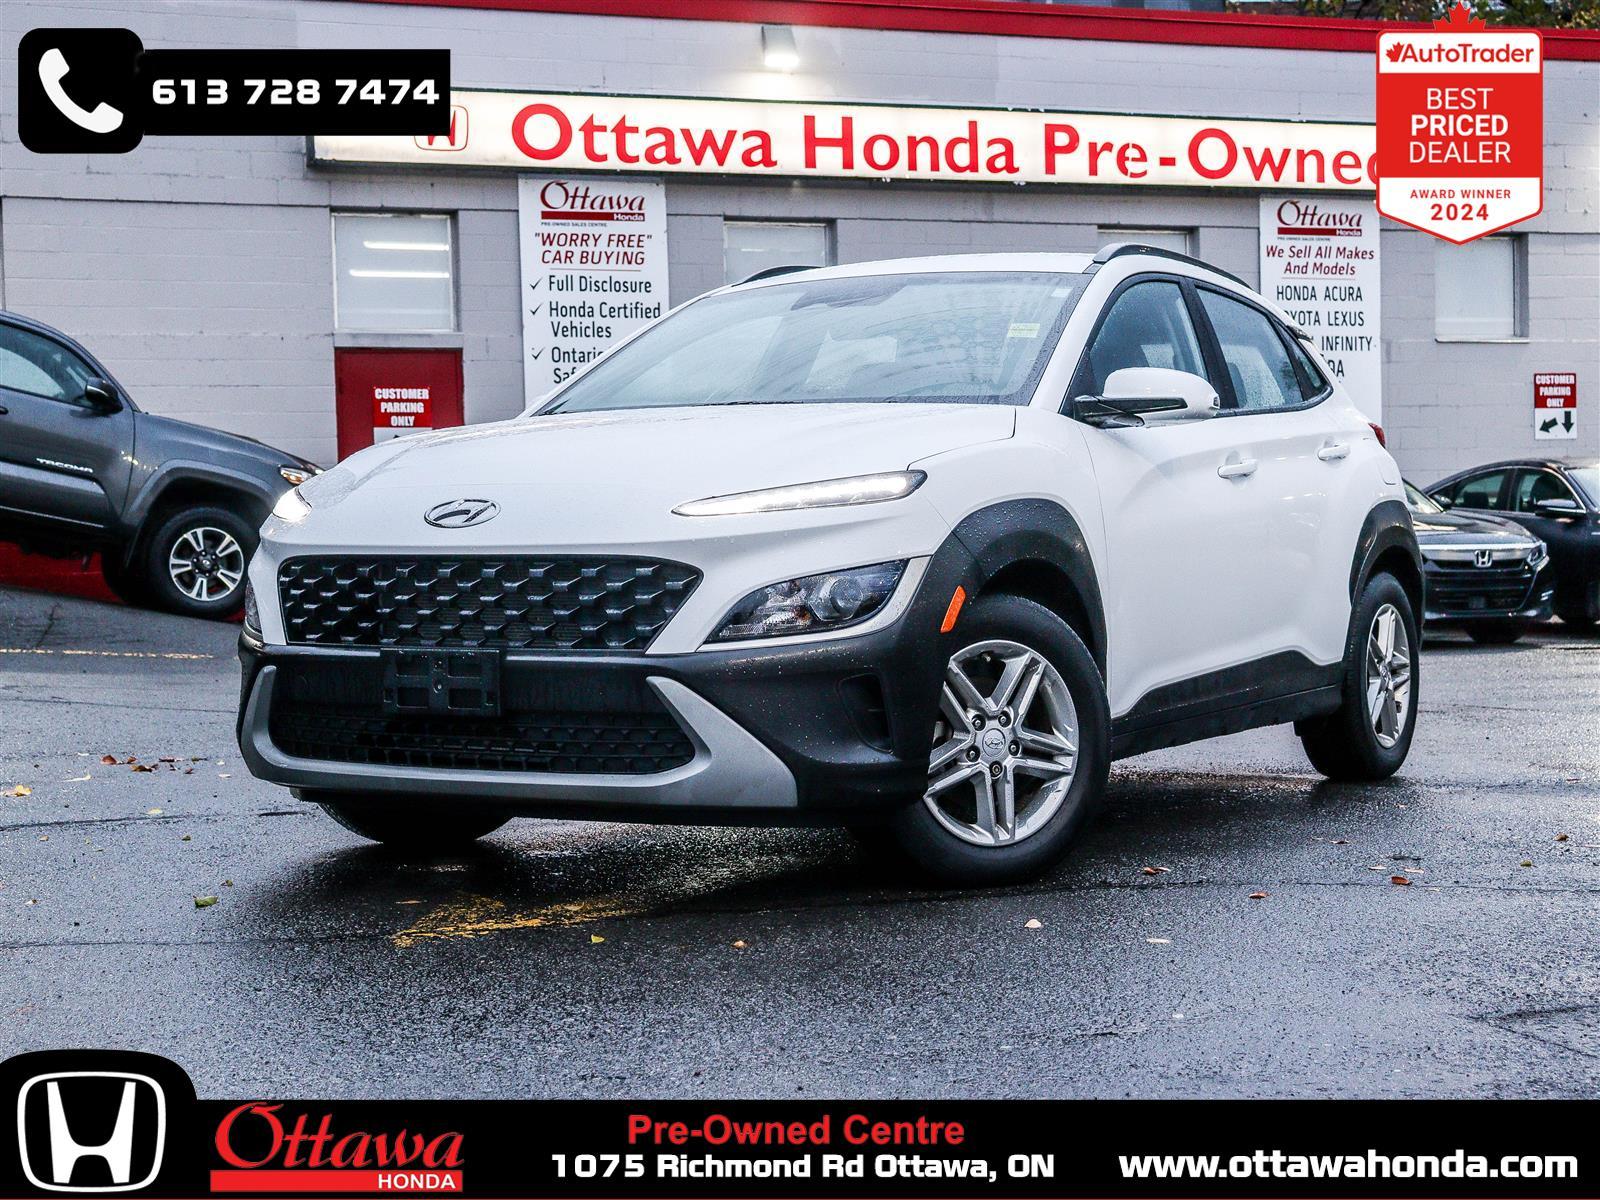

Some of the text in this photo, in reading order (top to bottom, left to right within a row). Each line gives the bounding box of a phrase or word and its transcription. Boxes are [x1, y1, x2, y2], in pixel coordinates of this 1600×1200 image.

[511, 102, 778, 168] Ottawa
[803, 114, 1020, 174] Honda
[540, 179, 645, 211] Ottawa
[613, 212, 645, 221] Honda
[1276, 200, 1363, 227] Ottawa
[535, 232, 653, 248] "WORRY FREE"
[541, 250, 646, 265] CAR BUYING
[1266, 245, 1374, 260] We Sell All Makes
[1284, 262, 1356, 276] And Models
[549, 275, 652, 293] Full Disclosure
[1276, 285, 1363, 301] HONDA ACURA
[549, 301, 661, 319] Honda Certified
[1327, 310, 1365, 326] LEXUS
[551, 321, 612, 338] Vehicles
[1321, 336, 1372, 351] INFINITY
[1535, 375, 1575, 385] CUSTOMER
[375, 388, 430, 400] CUSTOMER
[1539, 386, 1571, 396] PARKING
[380, 401, 425, 413] PARKING
[1546, 398, 1565, 408] ONLY
[390, 415, 415, 427] ONLY
[36, 457, 94, 473] TACOMA
